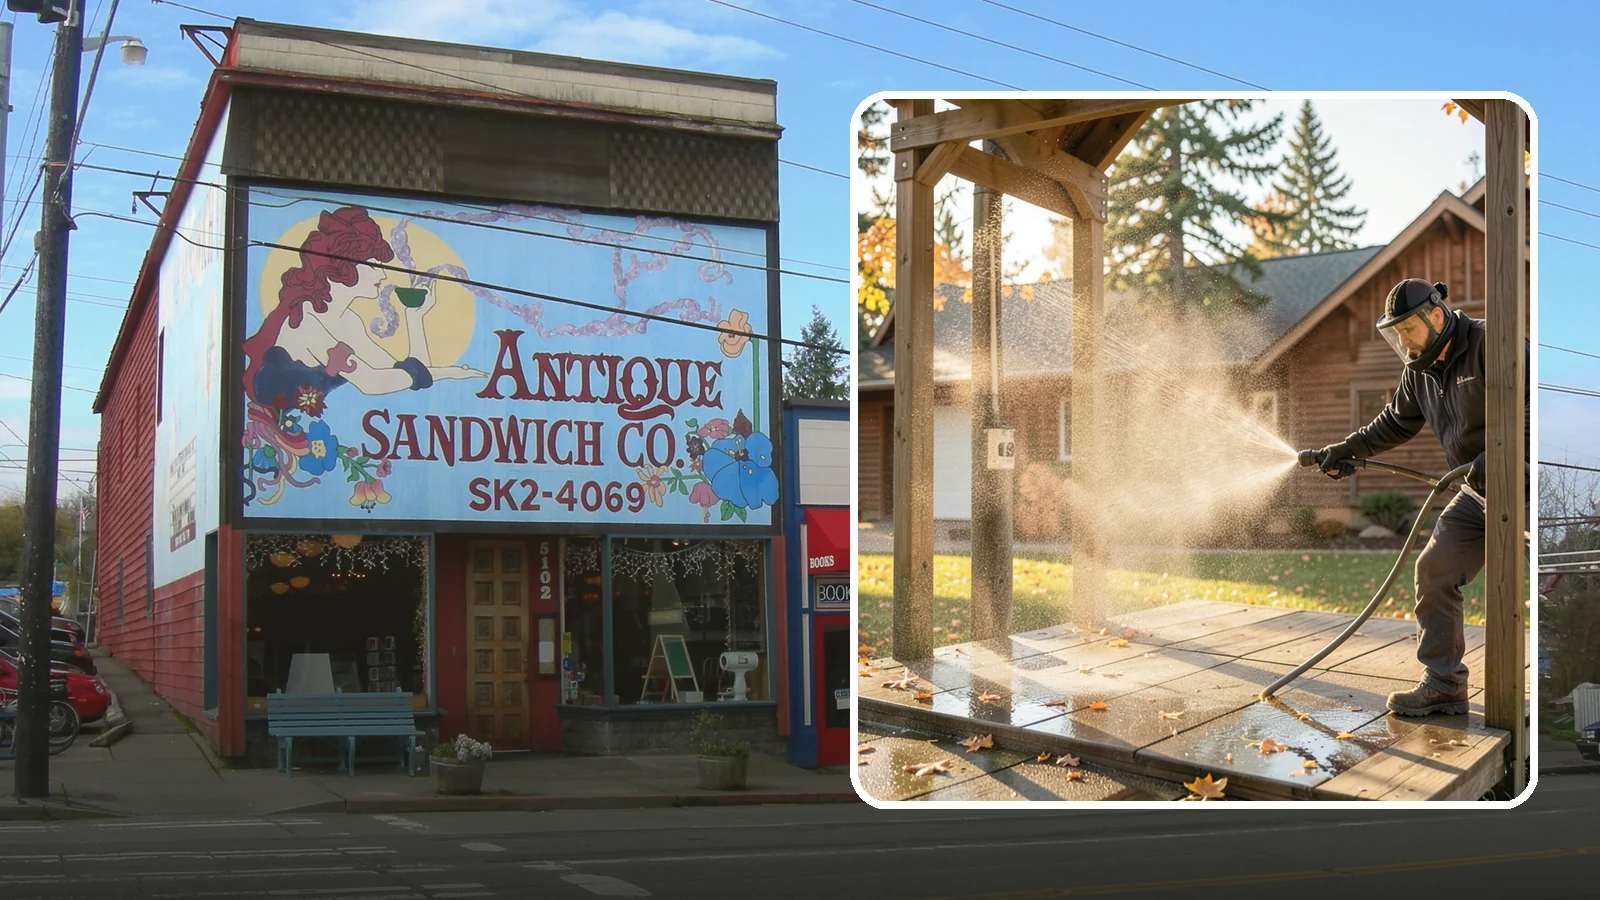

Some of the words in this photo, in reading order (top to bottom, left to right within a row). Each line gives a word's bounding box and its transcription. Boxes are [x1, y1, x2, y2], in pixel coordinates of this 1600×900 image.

[475, 328, 722, 420] ANTIQUE
[361, 408, 604, 467] SANDWICH
[616, 420, 686, 469] CO.
[468, 477, 647, 513] SK2-4069
[539, 541, 552, 600] 5102
[809, 555, 835, 569] BOOKS
